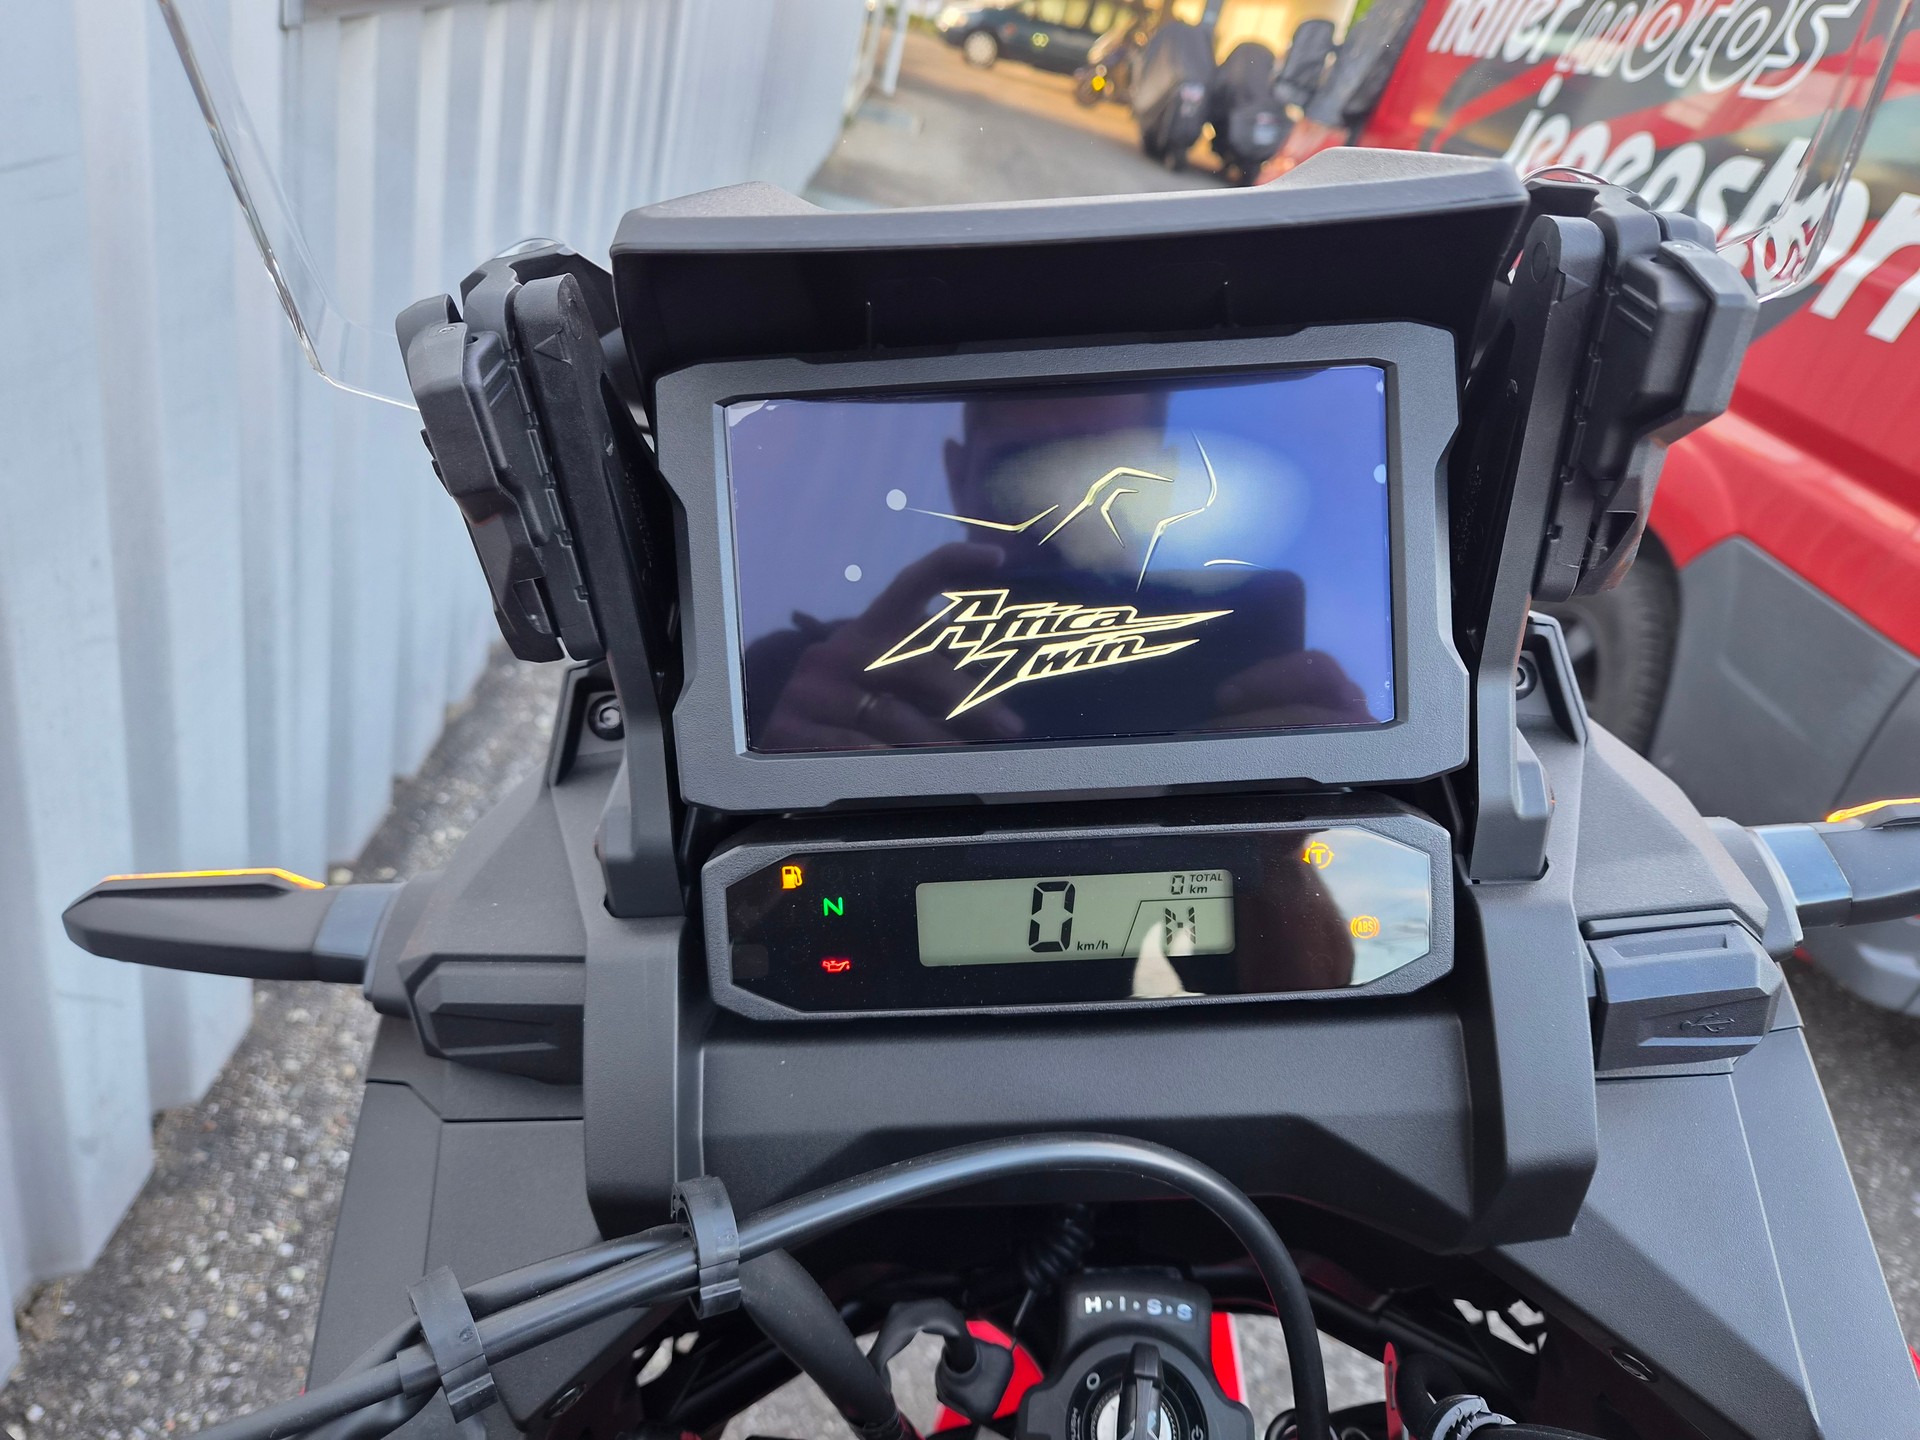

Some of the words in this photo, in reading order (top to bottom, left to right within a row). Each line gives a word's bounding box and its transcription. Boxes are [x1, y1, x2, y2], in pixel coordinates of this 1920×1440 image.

[864, 588, 1235, 672] Africa
[945, 634, 1200, 721] Twin
[1189, 873, 1224, 883] TOTAL
[1189, 884, 1208, 895] km
[823, 896, 844, 917] N
[1028, 880, 1076, 953] 0
[1076, 939, 1109, 952] km/h
